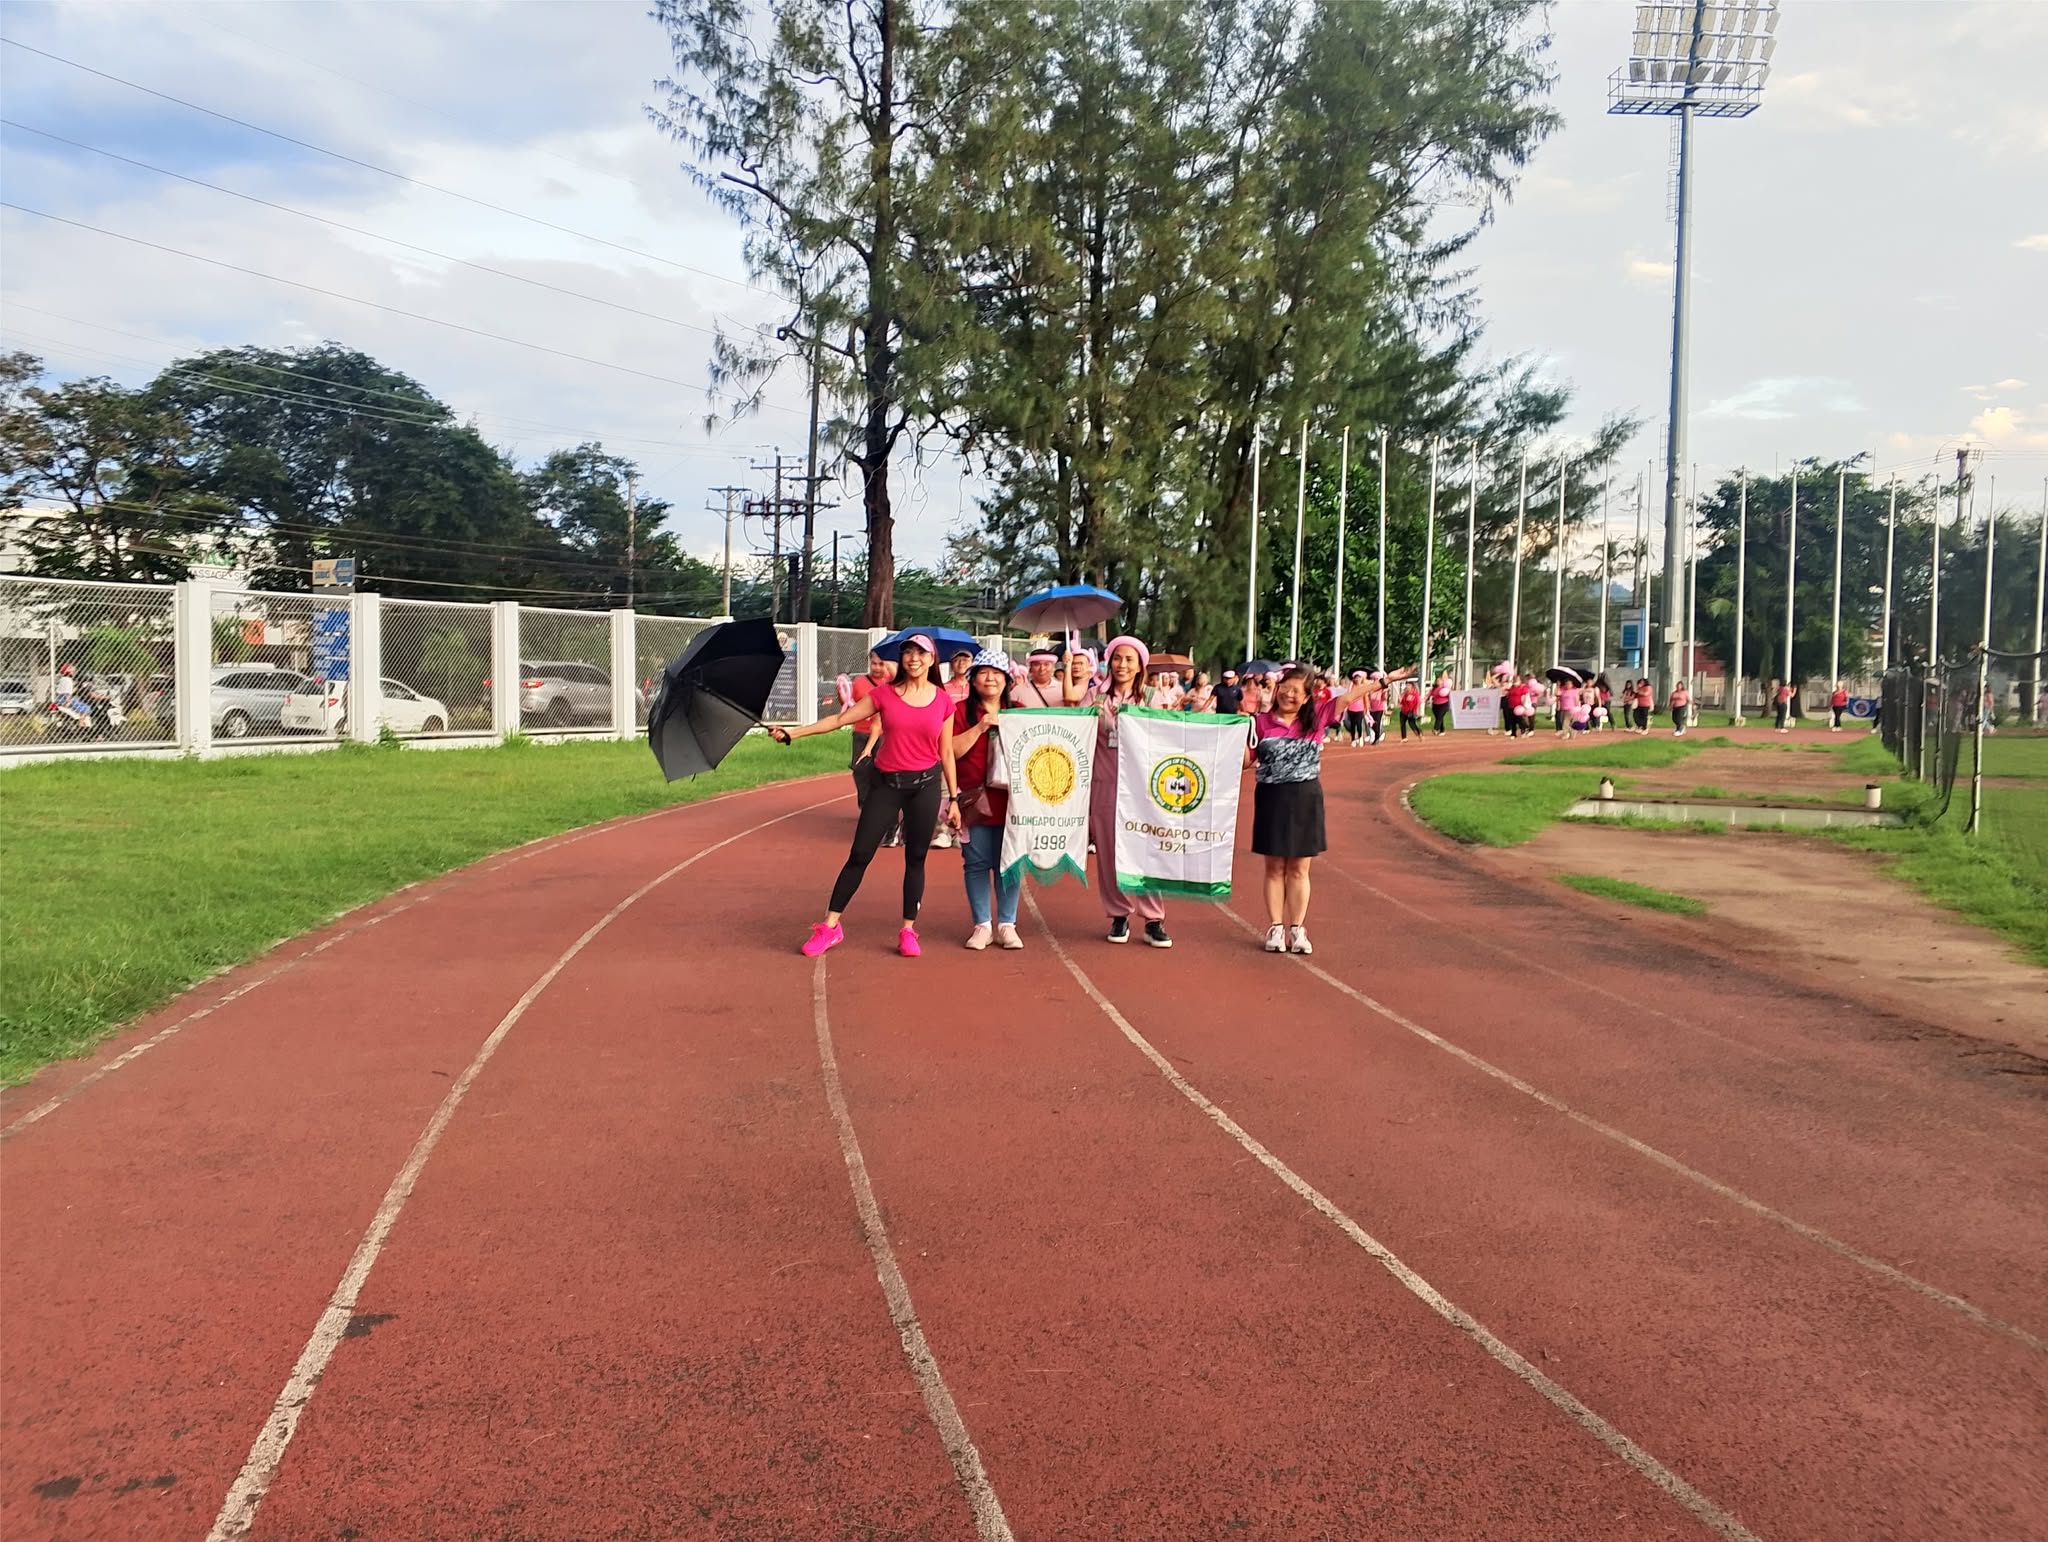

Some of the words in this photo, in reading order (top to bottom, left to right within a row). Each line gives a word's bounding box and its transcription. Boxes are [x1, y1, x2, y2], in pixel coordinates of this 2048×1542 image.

[188, 569, 227, 580] ASSAGE
[1011, 738, 1024, 774] COLLEGE
[1019, 729, 1031, 744] OF
[1028, 723, 1080, 749] OCCUPATIONAL
[1076, 747, 1090, 790] MEDICINE
[1010, 814, 1056, 827] OLONGAPO
[1124, 820, 1191, 841] OLONGAPO
[1194, 830, 1227, 842] CITY
[1033, 833, 1067, 851] 1998
[1158, 840, 1187, 855] 1974
